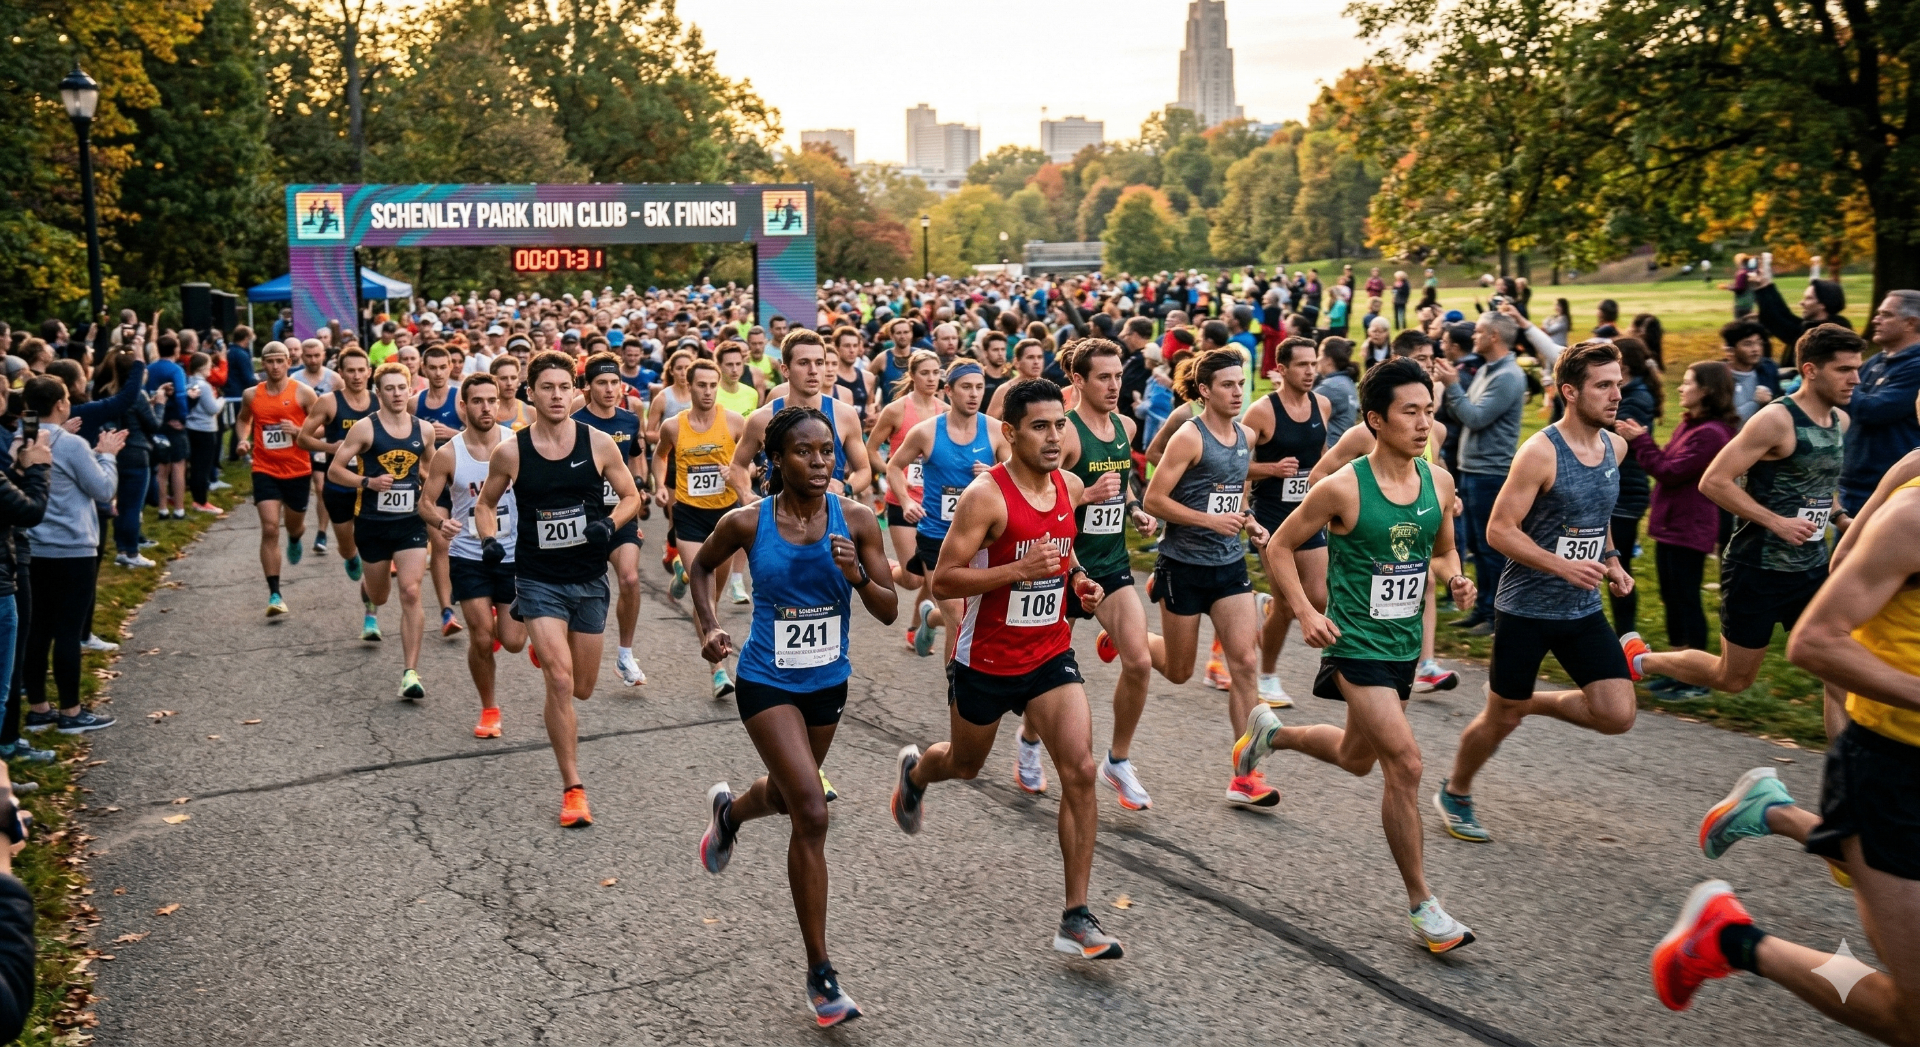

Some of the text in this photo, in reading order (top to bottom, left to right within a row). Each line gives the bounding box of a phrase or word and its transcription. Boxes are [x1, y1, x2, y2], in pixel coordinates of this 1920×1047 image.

[371, 202, 473, 229] SCHENLEY
[476, 202, 530, 229] PARK
[533, 201, 574, 228] RUN
[577, 201, 628, 228] CLUB
[644, 201, 672, 227] 5K
[674, 201, 737, 227] FINISH
[515, 249, 602, 270] 00:07:31
[266, 431, 287, 444] 201
[692, 474, 718, 489] 297
[383, 492, 408, 506] 201
[1213, 495, 1239, 513] 330
[1092, 508, 1120, 526] 312
[544, 520, 578, 541] 201
[1563, 540, 1598, 560] 350
[1380, 576, 1419, 601] 312
[1020, 593, 1056, 617] 108
[786, 621, 828, 649] 241
